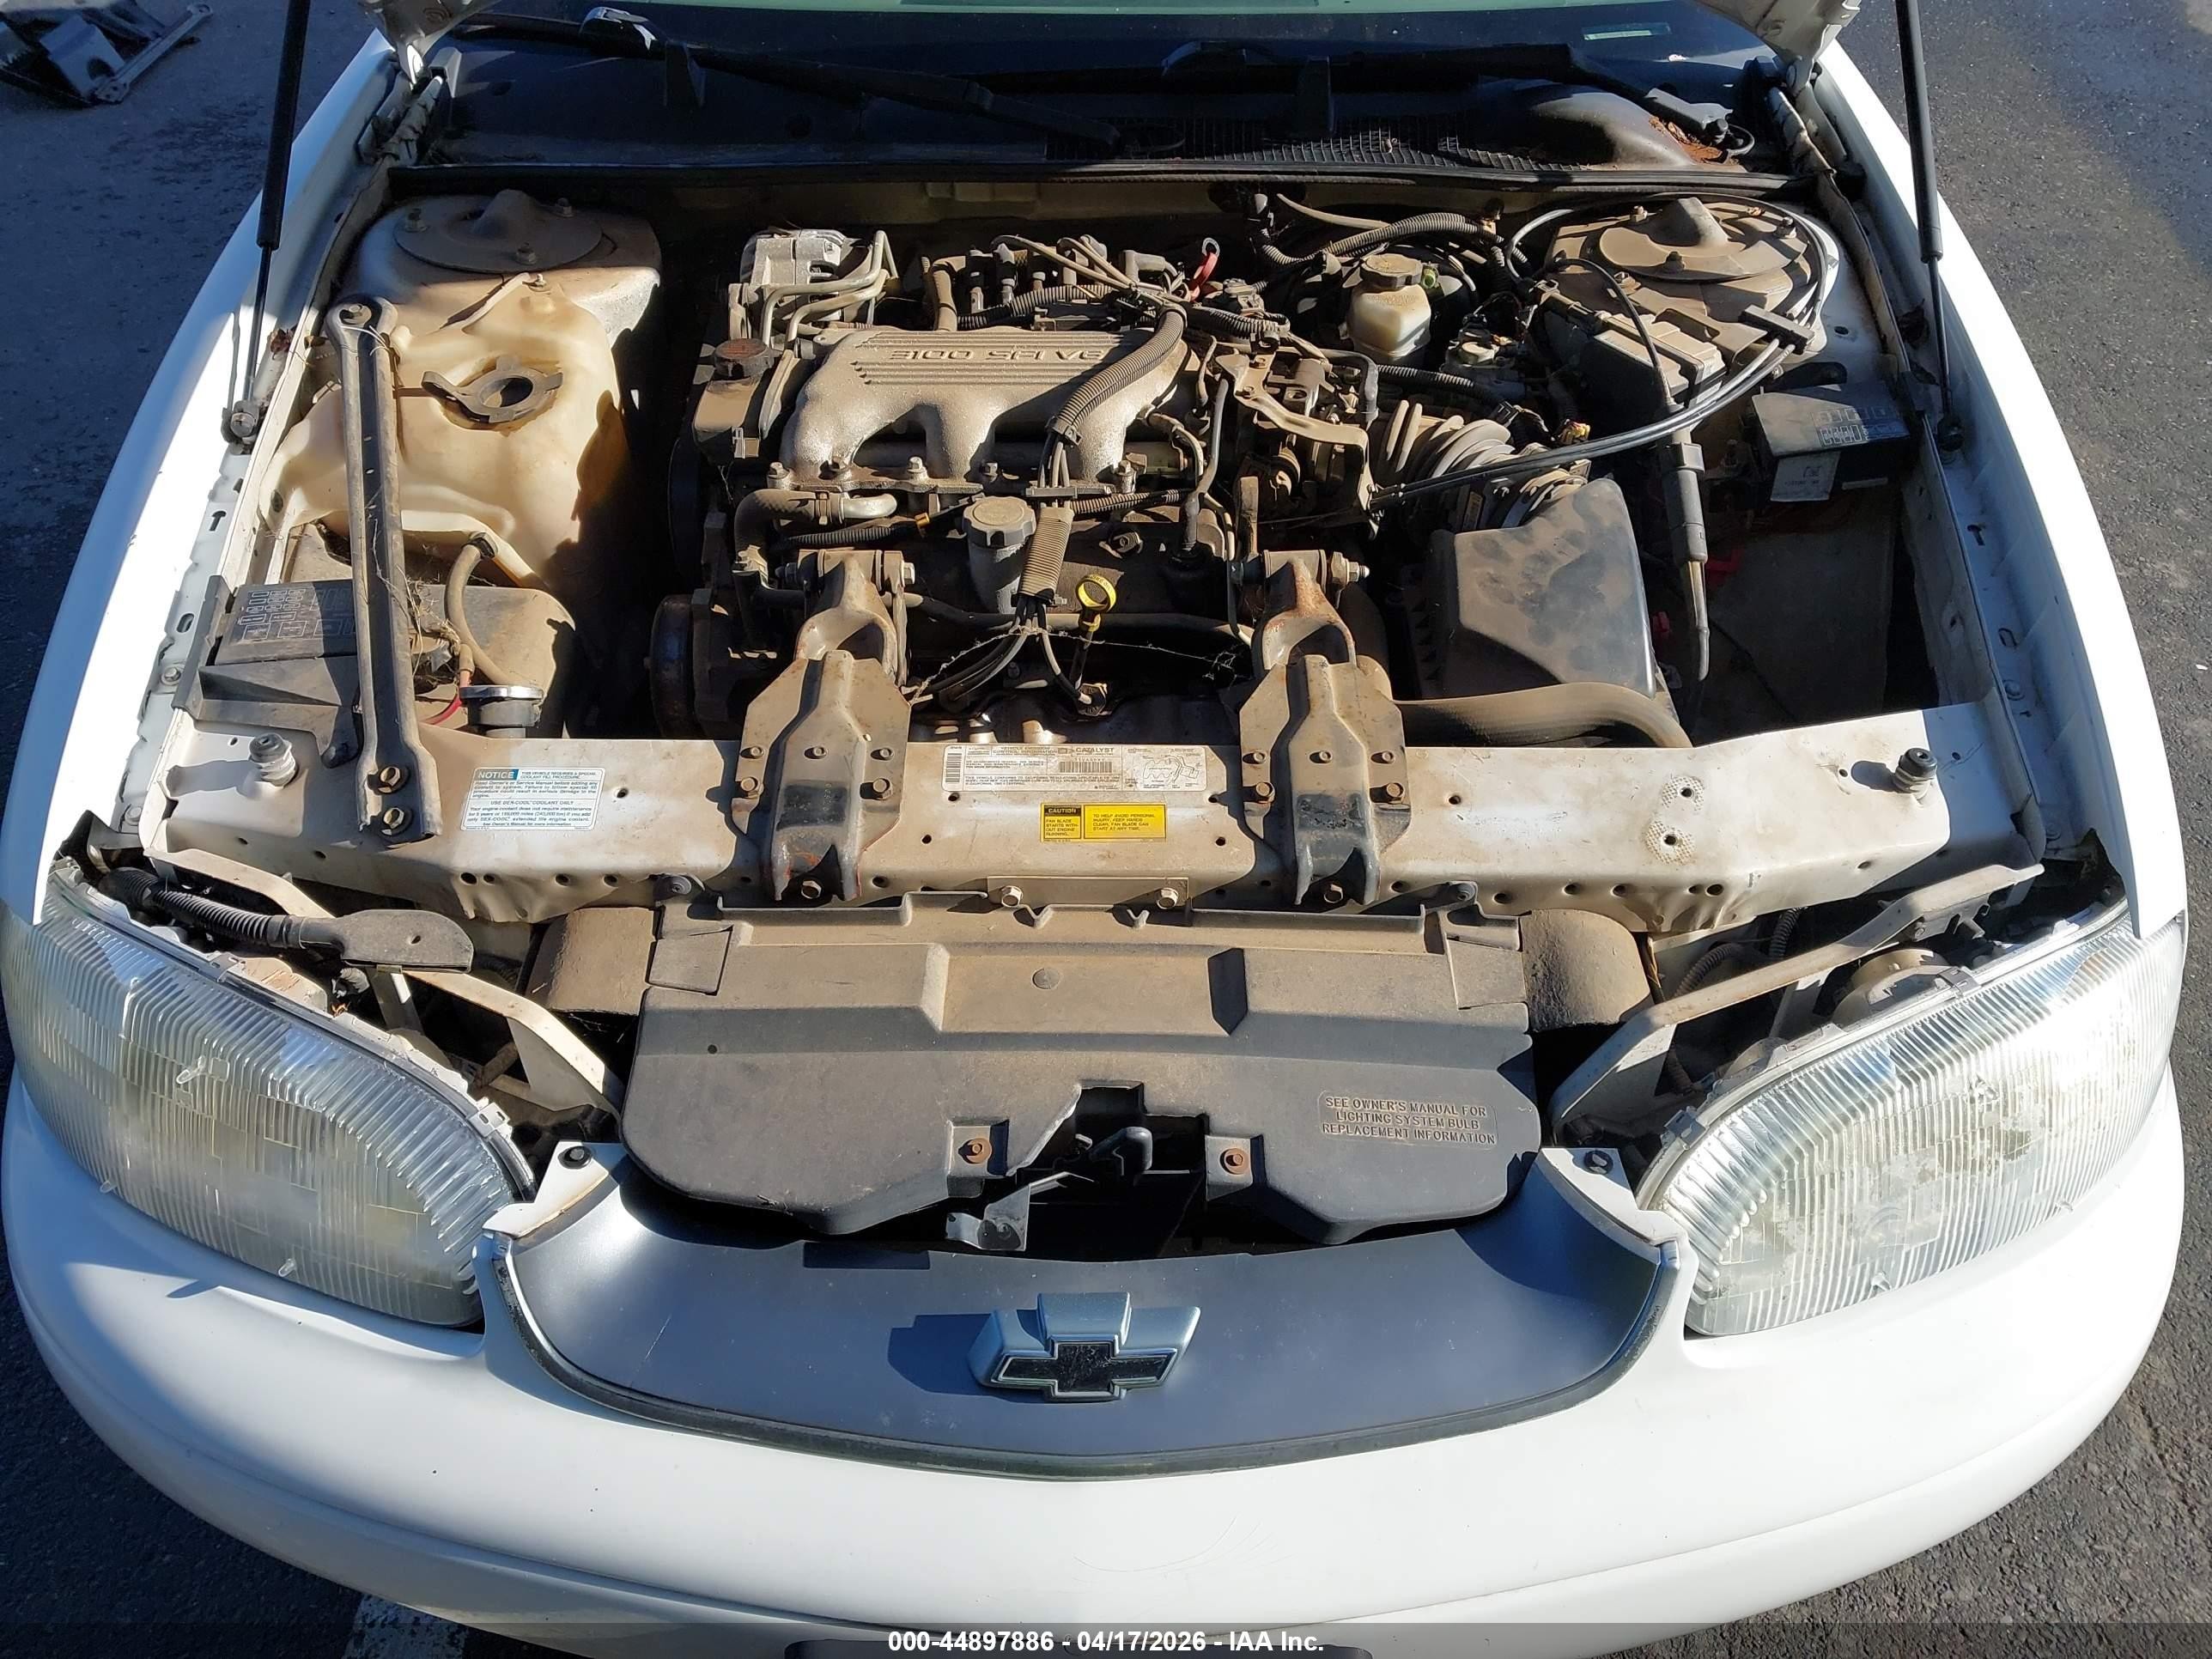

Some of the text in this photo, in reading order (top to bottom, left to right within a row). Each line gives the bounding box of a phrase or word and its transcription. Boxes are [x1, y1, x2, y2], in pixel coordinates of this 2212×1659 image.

[890, 349, 1105, 361] 3100 SFI V6
[1326, 1097, 1486, 1116] SEE OWNER'S MANUAL FOR
[1336, 1111, 1479, 1130] LIGHTING SYSTEM BULB
[1322, 1124, 1495, 1145] REPLACEMENT INFORMATION
